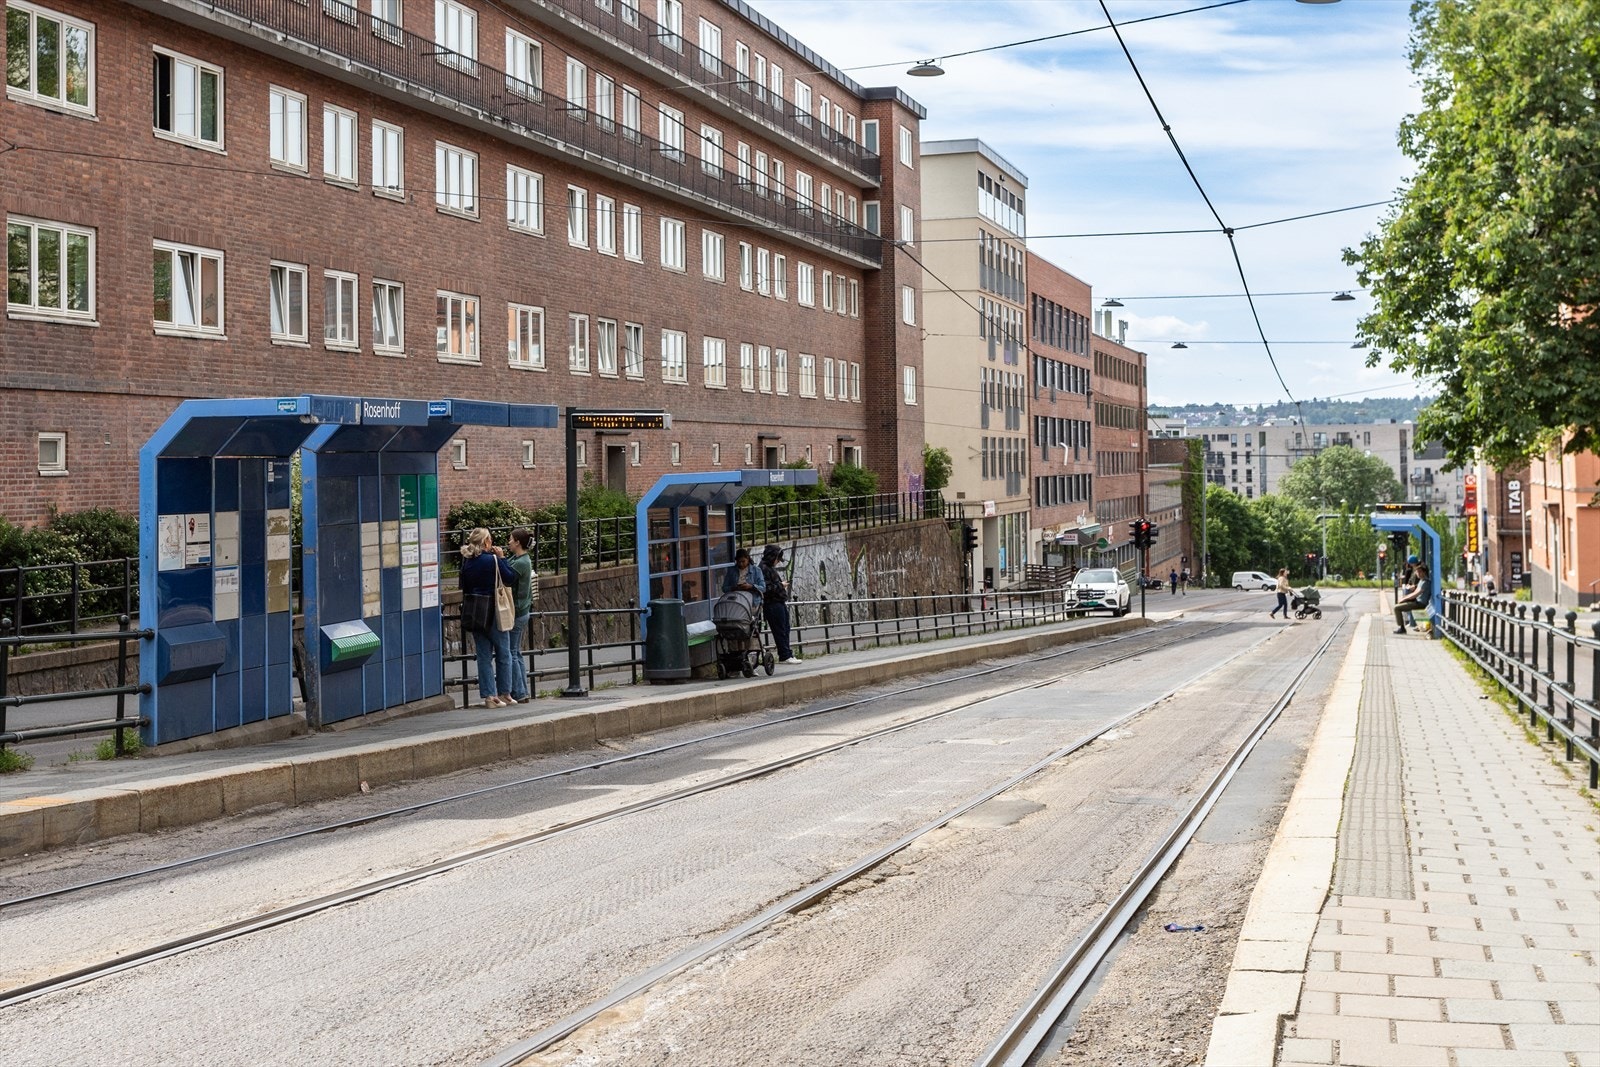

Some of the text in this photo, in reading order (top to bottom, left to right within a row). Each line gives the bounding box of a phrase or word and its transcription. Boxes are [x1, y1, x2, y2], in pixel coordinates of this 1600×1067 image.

[363, 401, 400, 418] Rosenhoff
[1508, 480, 1521, 514] ITAB
[1469, 515, 1477, 552] KEBAB
